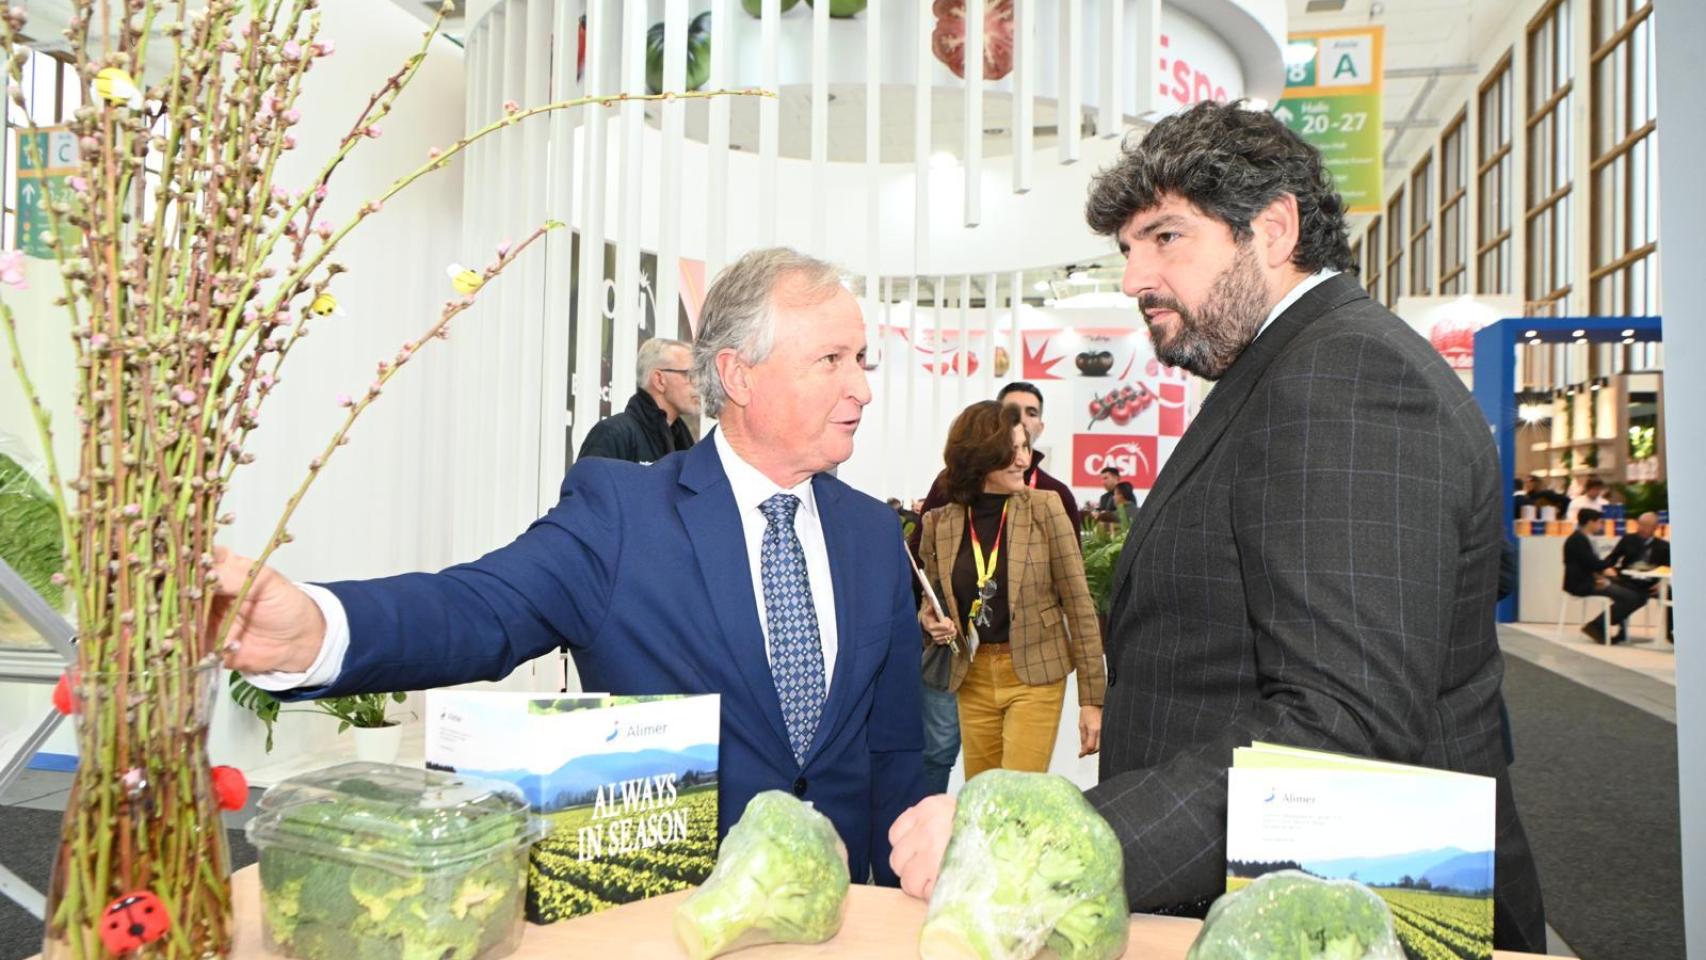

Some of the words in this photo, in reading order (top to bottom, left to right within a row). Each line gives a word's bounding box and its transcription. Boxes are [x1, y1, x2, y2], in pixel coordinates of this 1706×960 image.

[1333, 53, 1358, 79] A
[1303, 113, 1367, 134] 20-27
[58, 143, 71, 162] C
[1084, 454, 1139, 477] CASI
[627, 723, 668, 737] Alimer
[592, 772, 677, 820] ALWAYS
[578, 824, 604, 863] IN
[608, 807, 690, 857] SEASON
